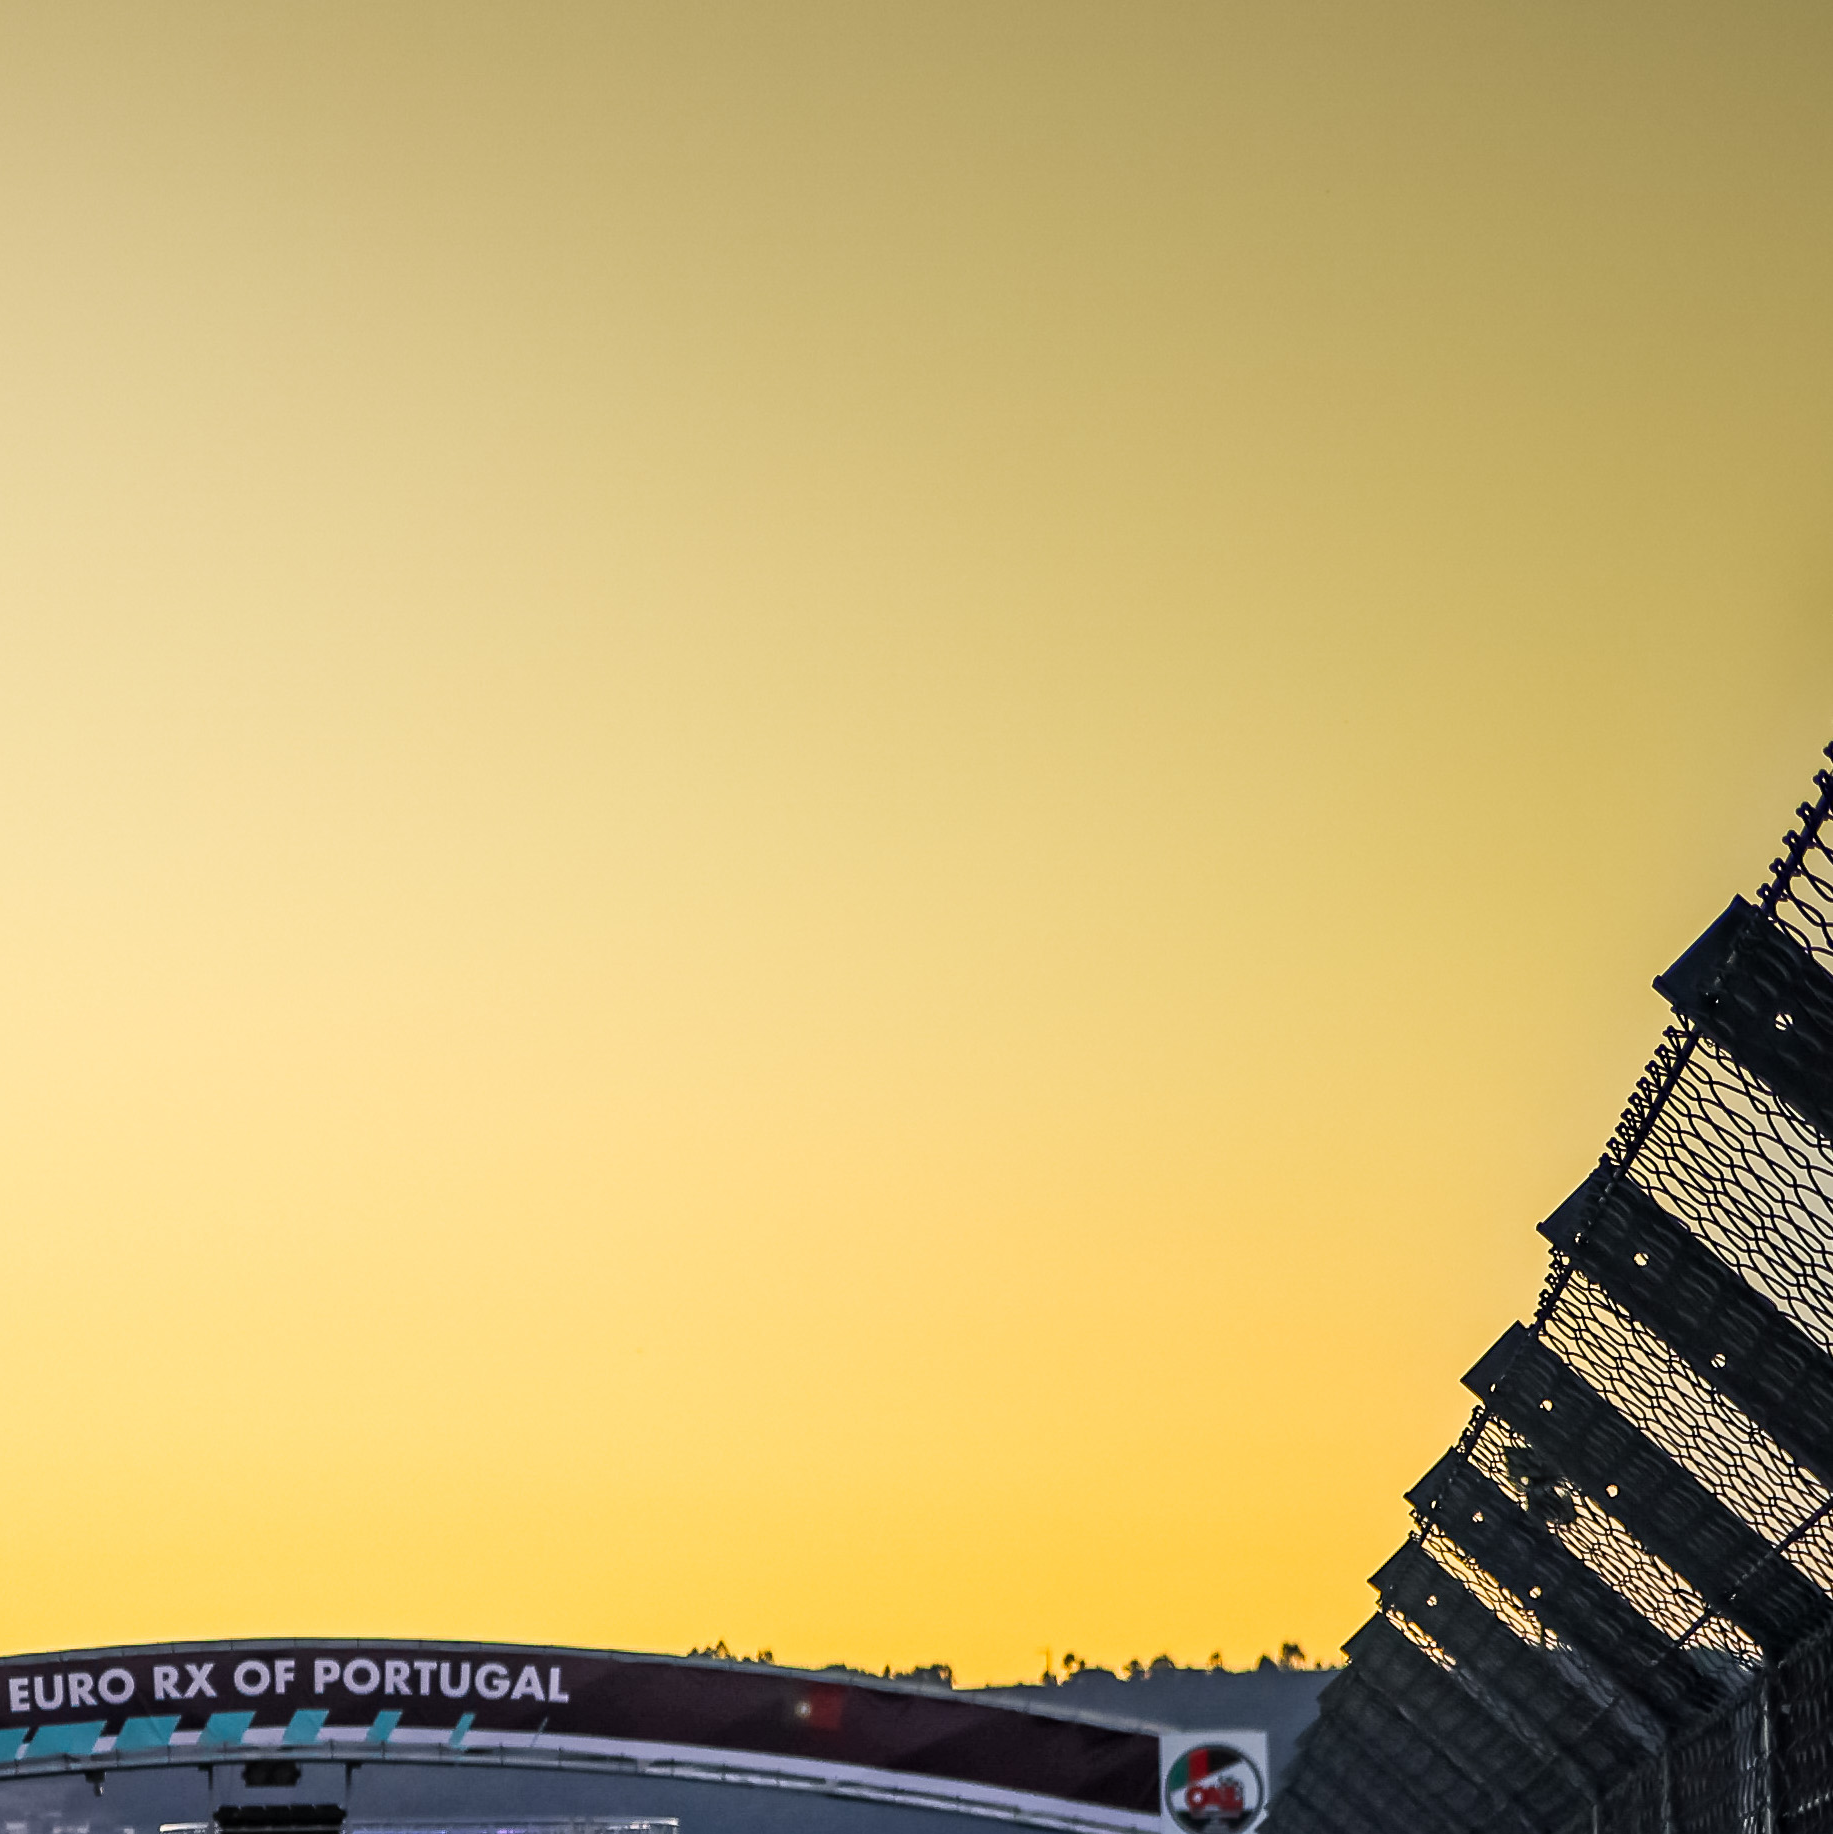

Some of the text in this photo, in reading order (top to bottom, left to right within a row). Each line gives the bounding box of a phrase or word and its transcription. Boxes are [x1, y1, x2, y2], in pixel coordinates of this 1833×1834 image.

[9, 1659, 570, 1713] EURO RX OF PORTUGAL
